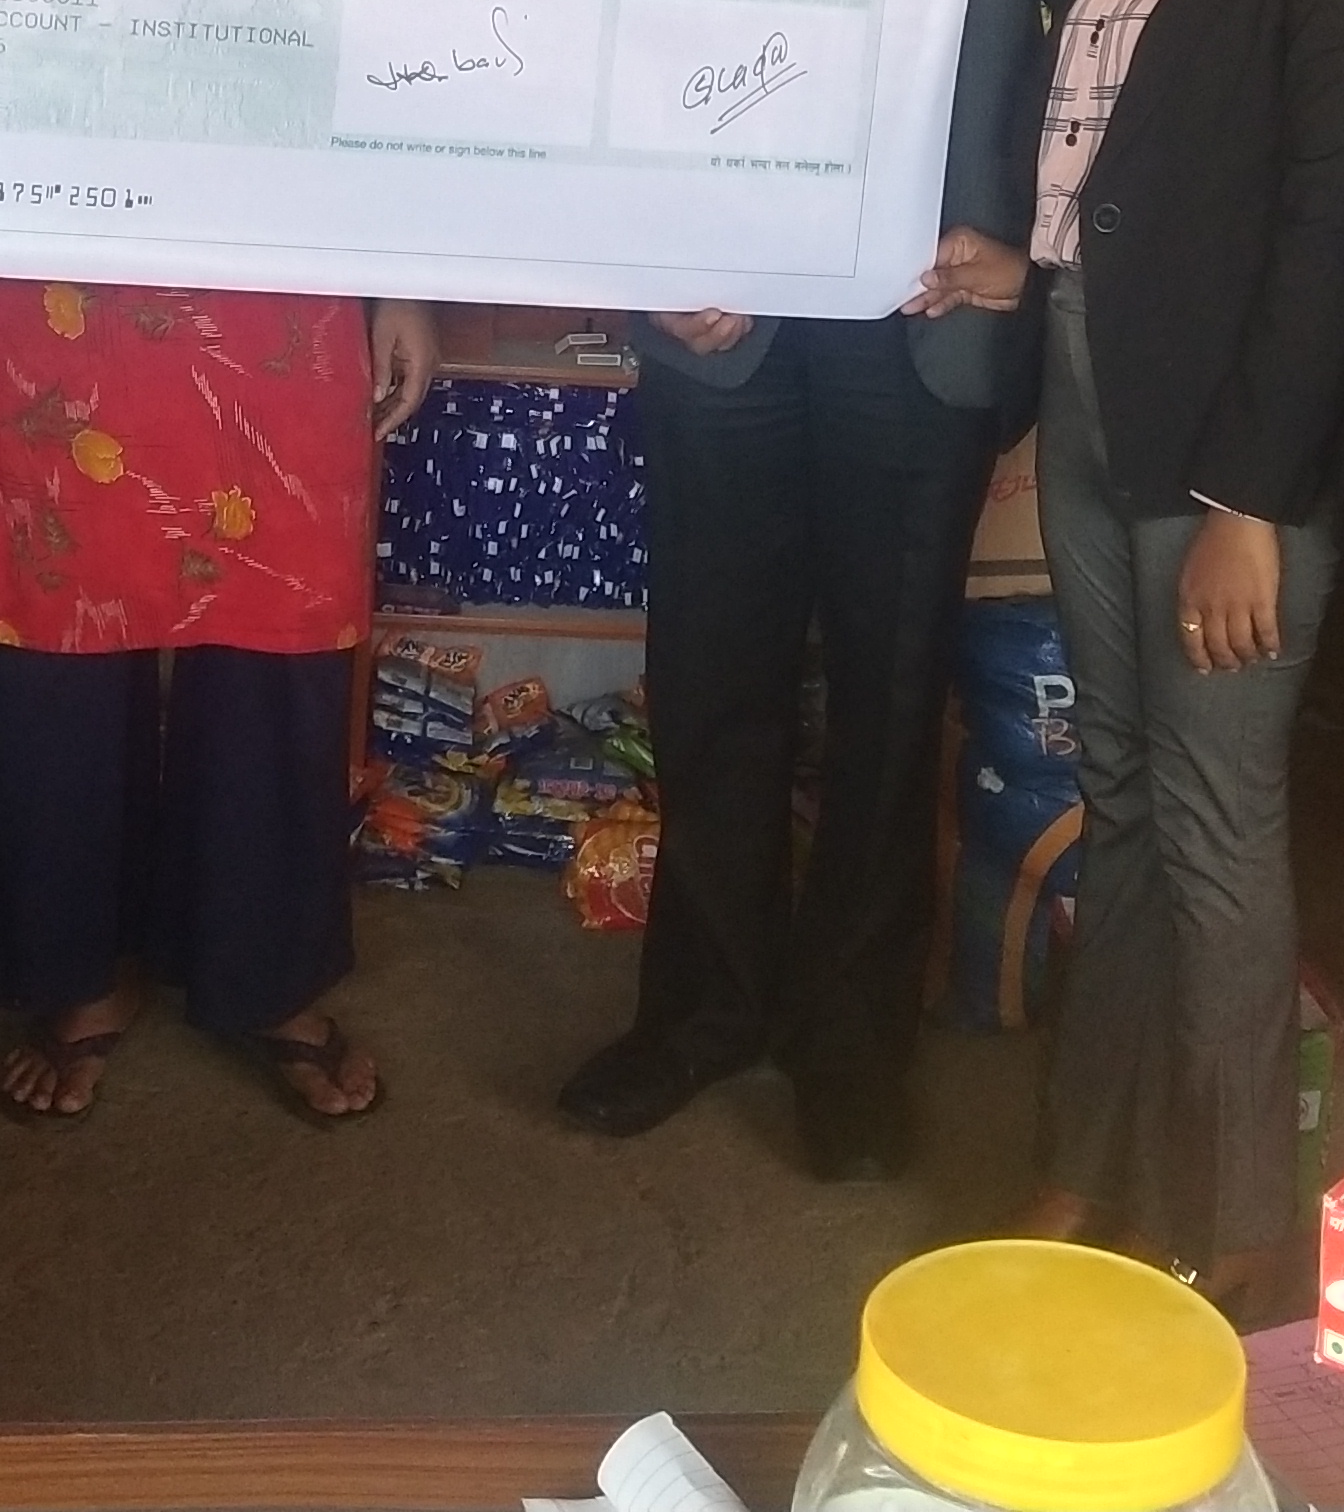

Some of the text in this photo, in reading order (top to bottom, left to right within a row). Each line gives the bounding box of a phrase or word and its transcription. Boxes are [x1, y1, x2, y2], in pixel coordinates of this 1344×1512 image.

[130, 18, 315, 48] INSTITUTIONAL
[330, 135, 547, 160] Please do not write or sign below this line
